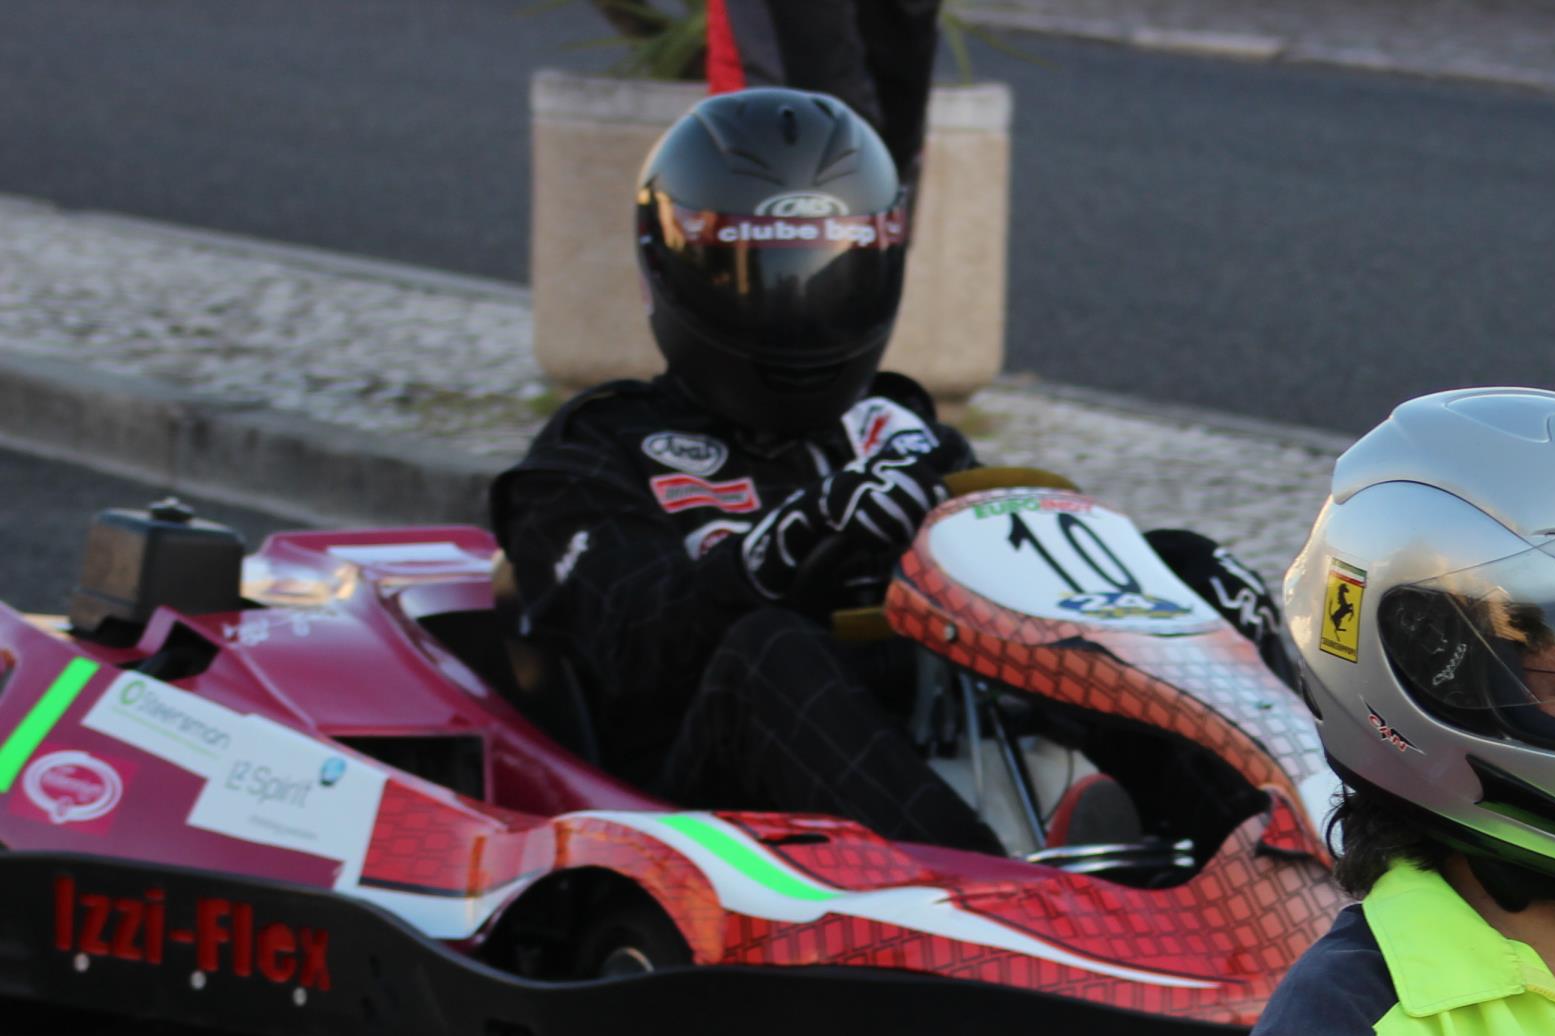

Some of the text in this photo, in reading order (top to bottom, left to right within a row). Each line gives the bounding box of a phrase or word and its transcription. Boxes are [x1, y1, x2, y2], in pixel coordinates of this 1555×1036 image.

[717, 221, 820, 244] clube
[1006, 510, 1144, 596] 10
[53, 875, 332, 991] Izzi-Flex
